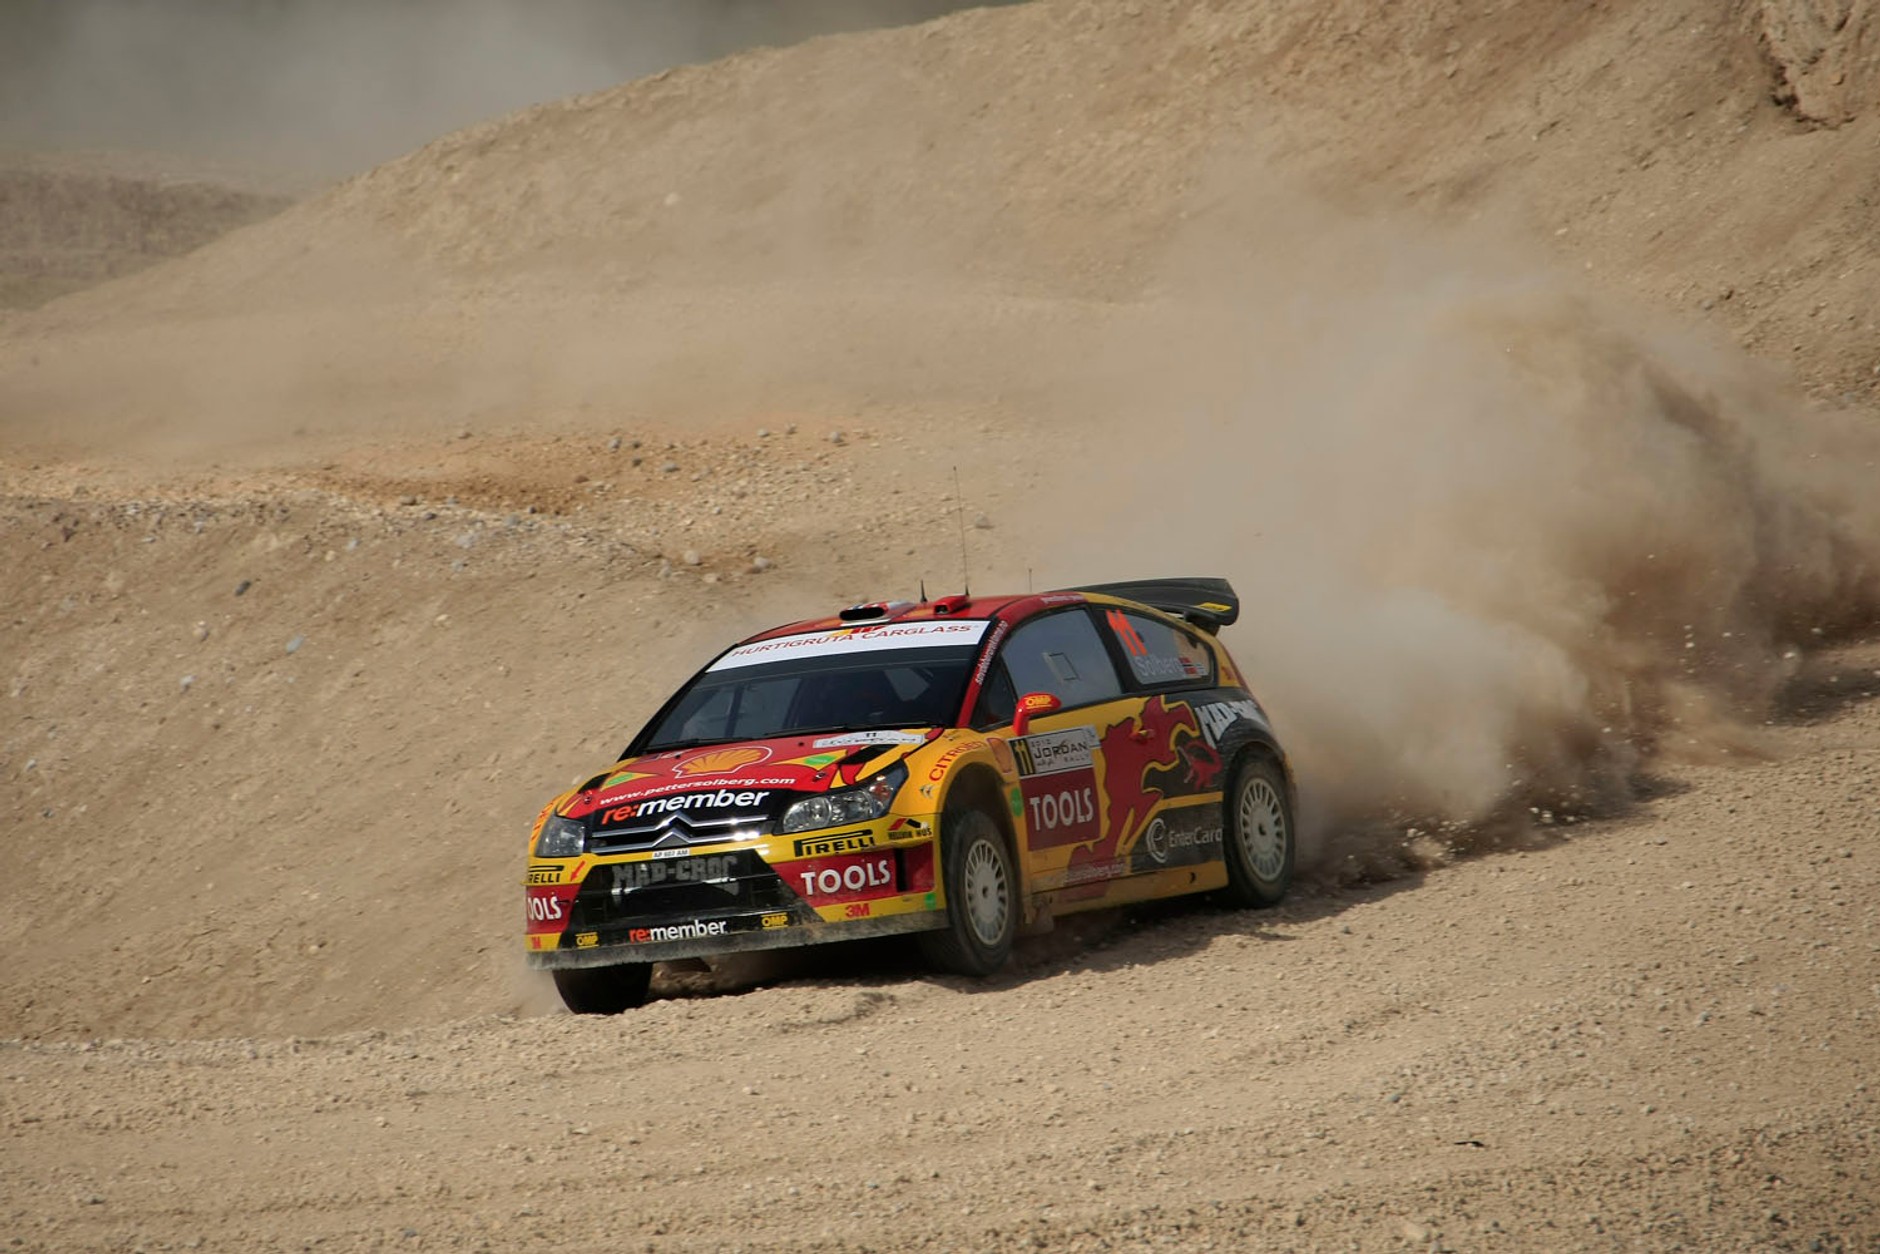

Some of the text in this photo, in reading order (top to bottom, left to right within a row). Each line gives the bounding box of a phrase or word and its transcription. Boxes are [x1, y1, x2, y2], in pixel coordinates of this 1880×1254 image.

[732, 624, 973, 657] HURTIGRUTA CARGLASS
[1034, 741, 1089, 759] JORDAN
[600, 777, 796, 805] www.pettersolberg.com
[602, 789, 770, 825] re:member
[1029, 787, 1094, 831] TOOLS
[793, 828, 876, 857] PIRELLI
[801, 860, 891, 896] TOOLS
[762, 914, 788, 928] OMP
[845, 903, 870, 918] 3M
[629, 919, 728, 944] re:member
